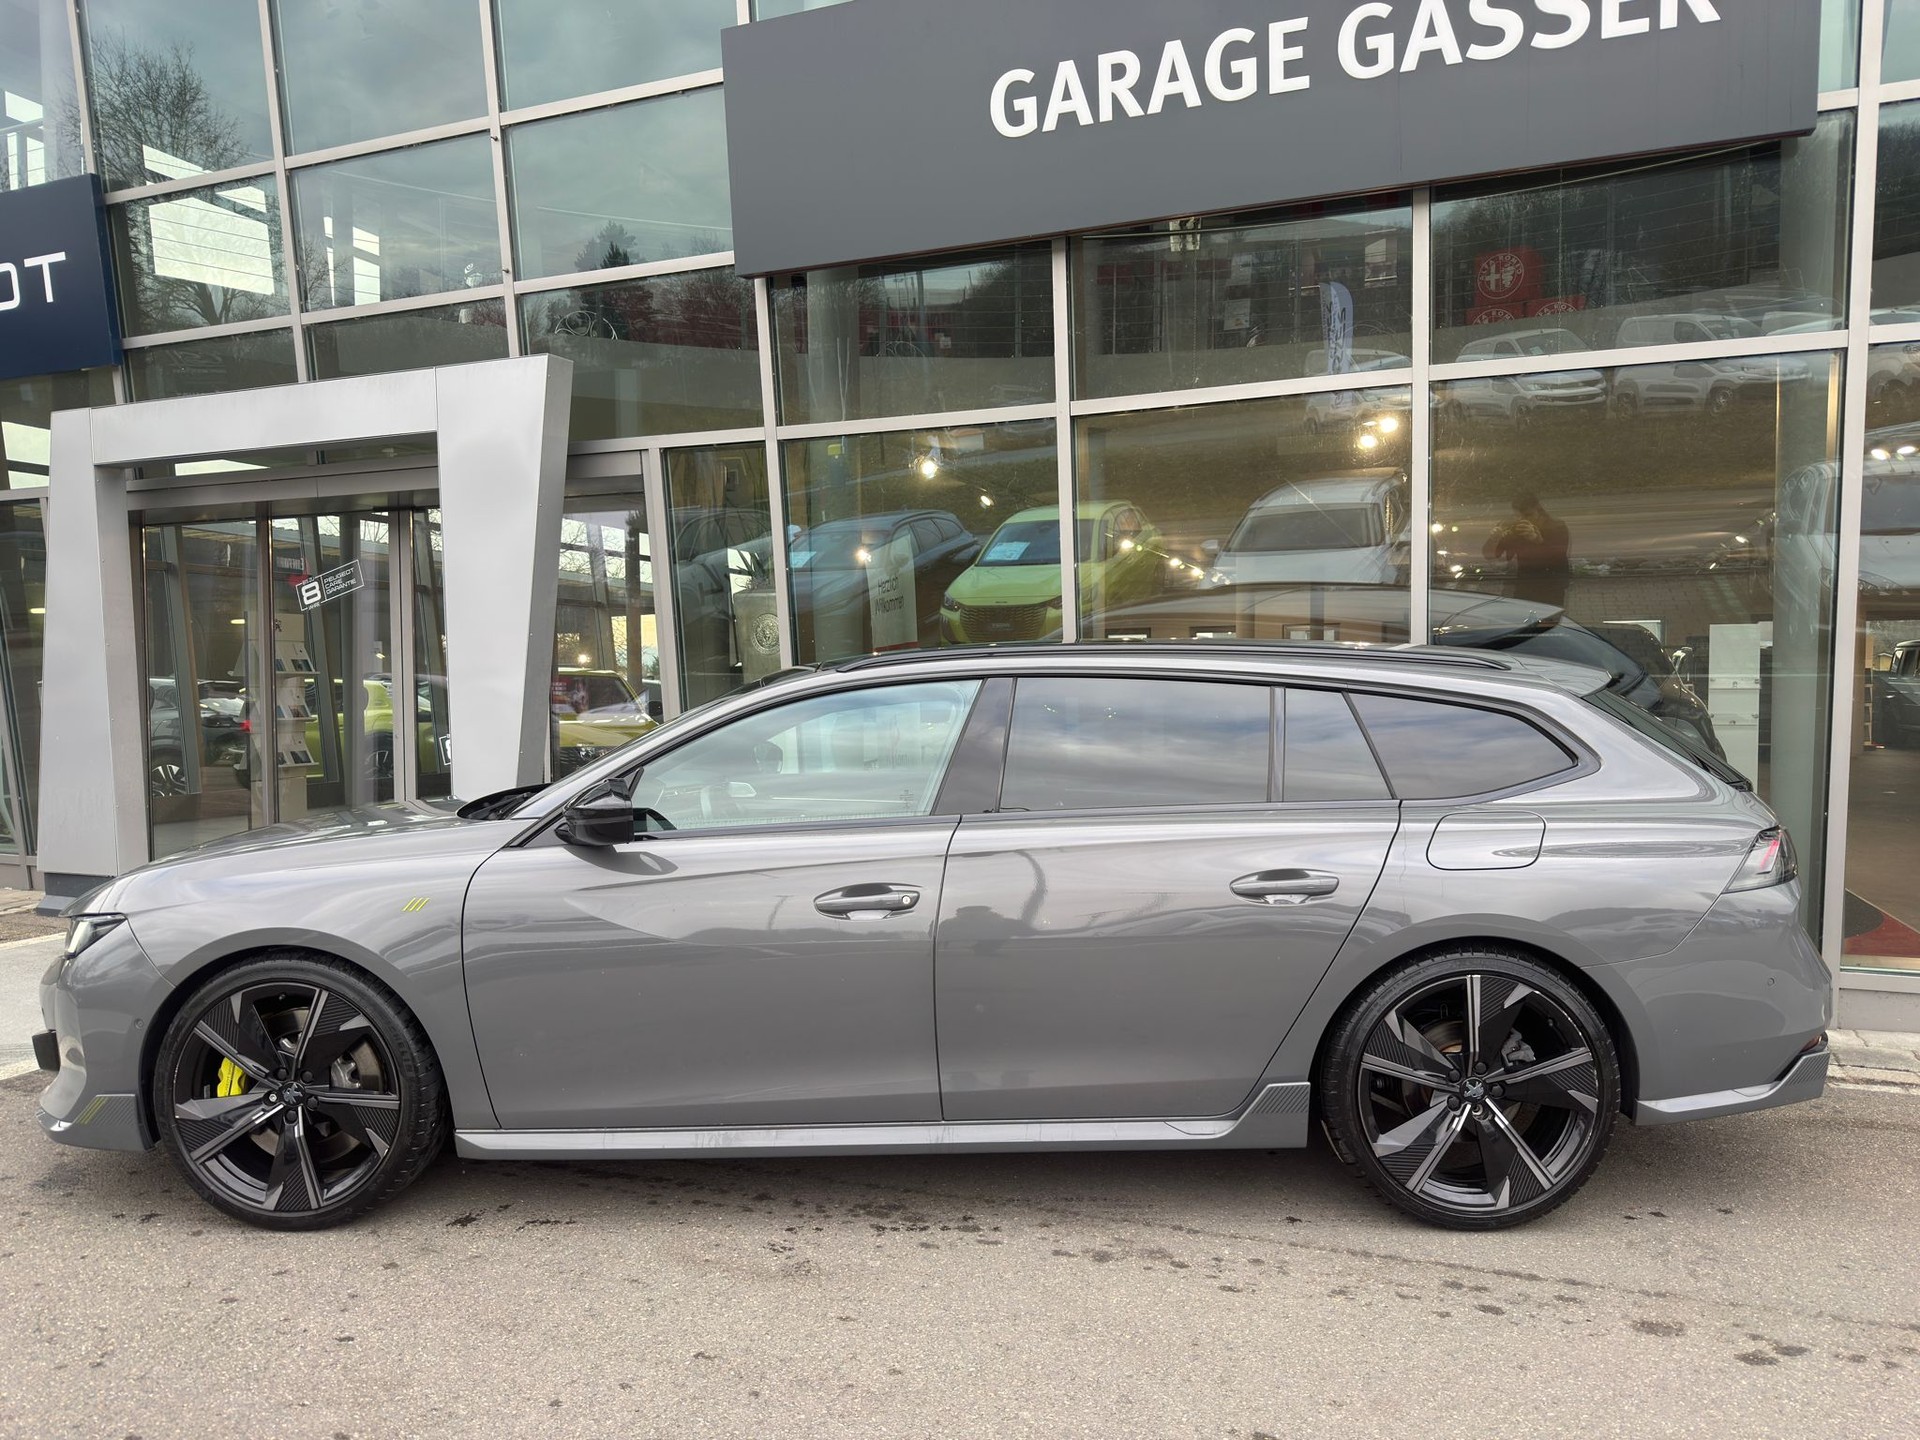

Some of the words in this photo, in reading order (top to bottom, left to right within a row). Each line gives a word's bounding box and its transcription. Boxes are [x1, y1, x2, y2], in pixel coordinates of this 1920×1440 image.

[989, 17, 1310, 138] GARAGE
[323, 567, 355, 584] PEUGEOT
[325, 578, 343, 590] CARE
[301, 581, 322, 605] 8
[326, 577, 357, 595] GARANTIE
